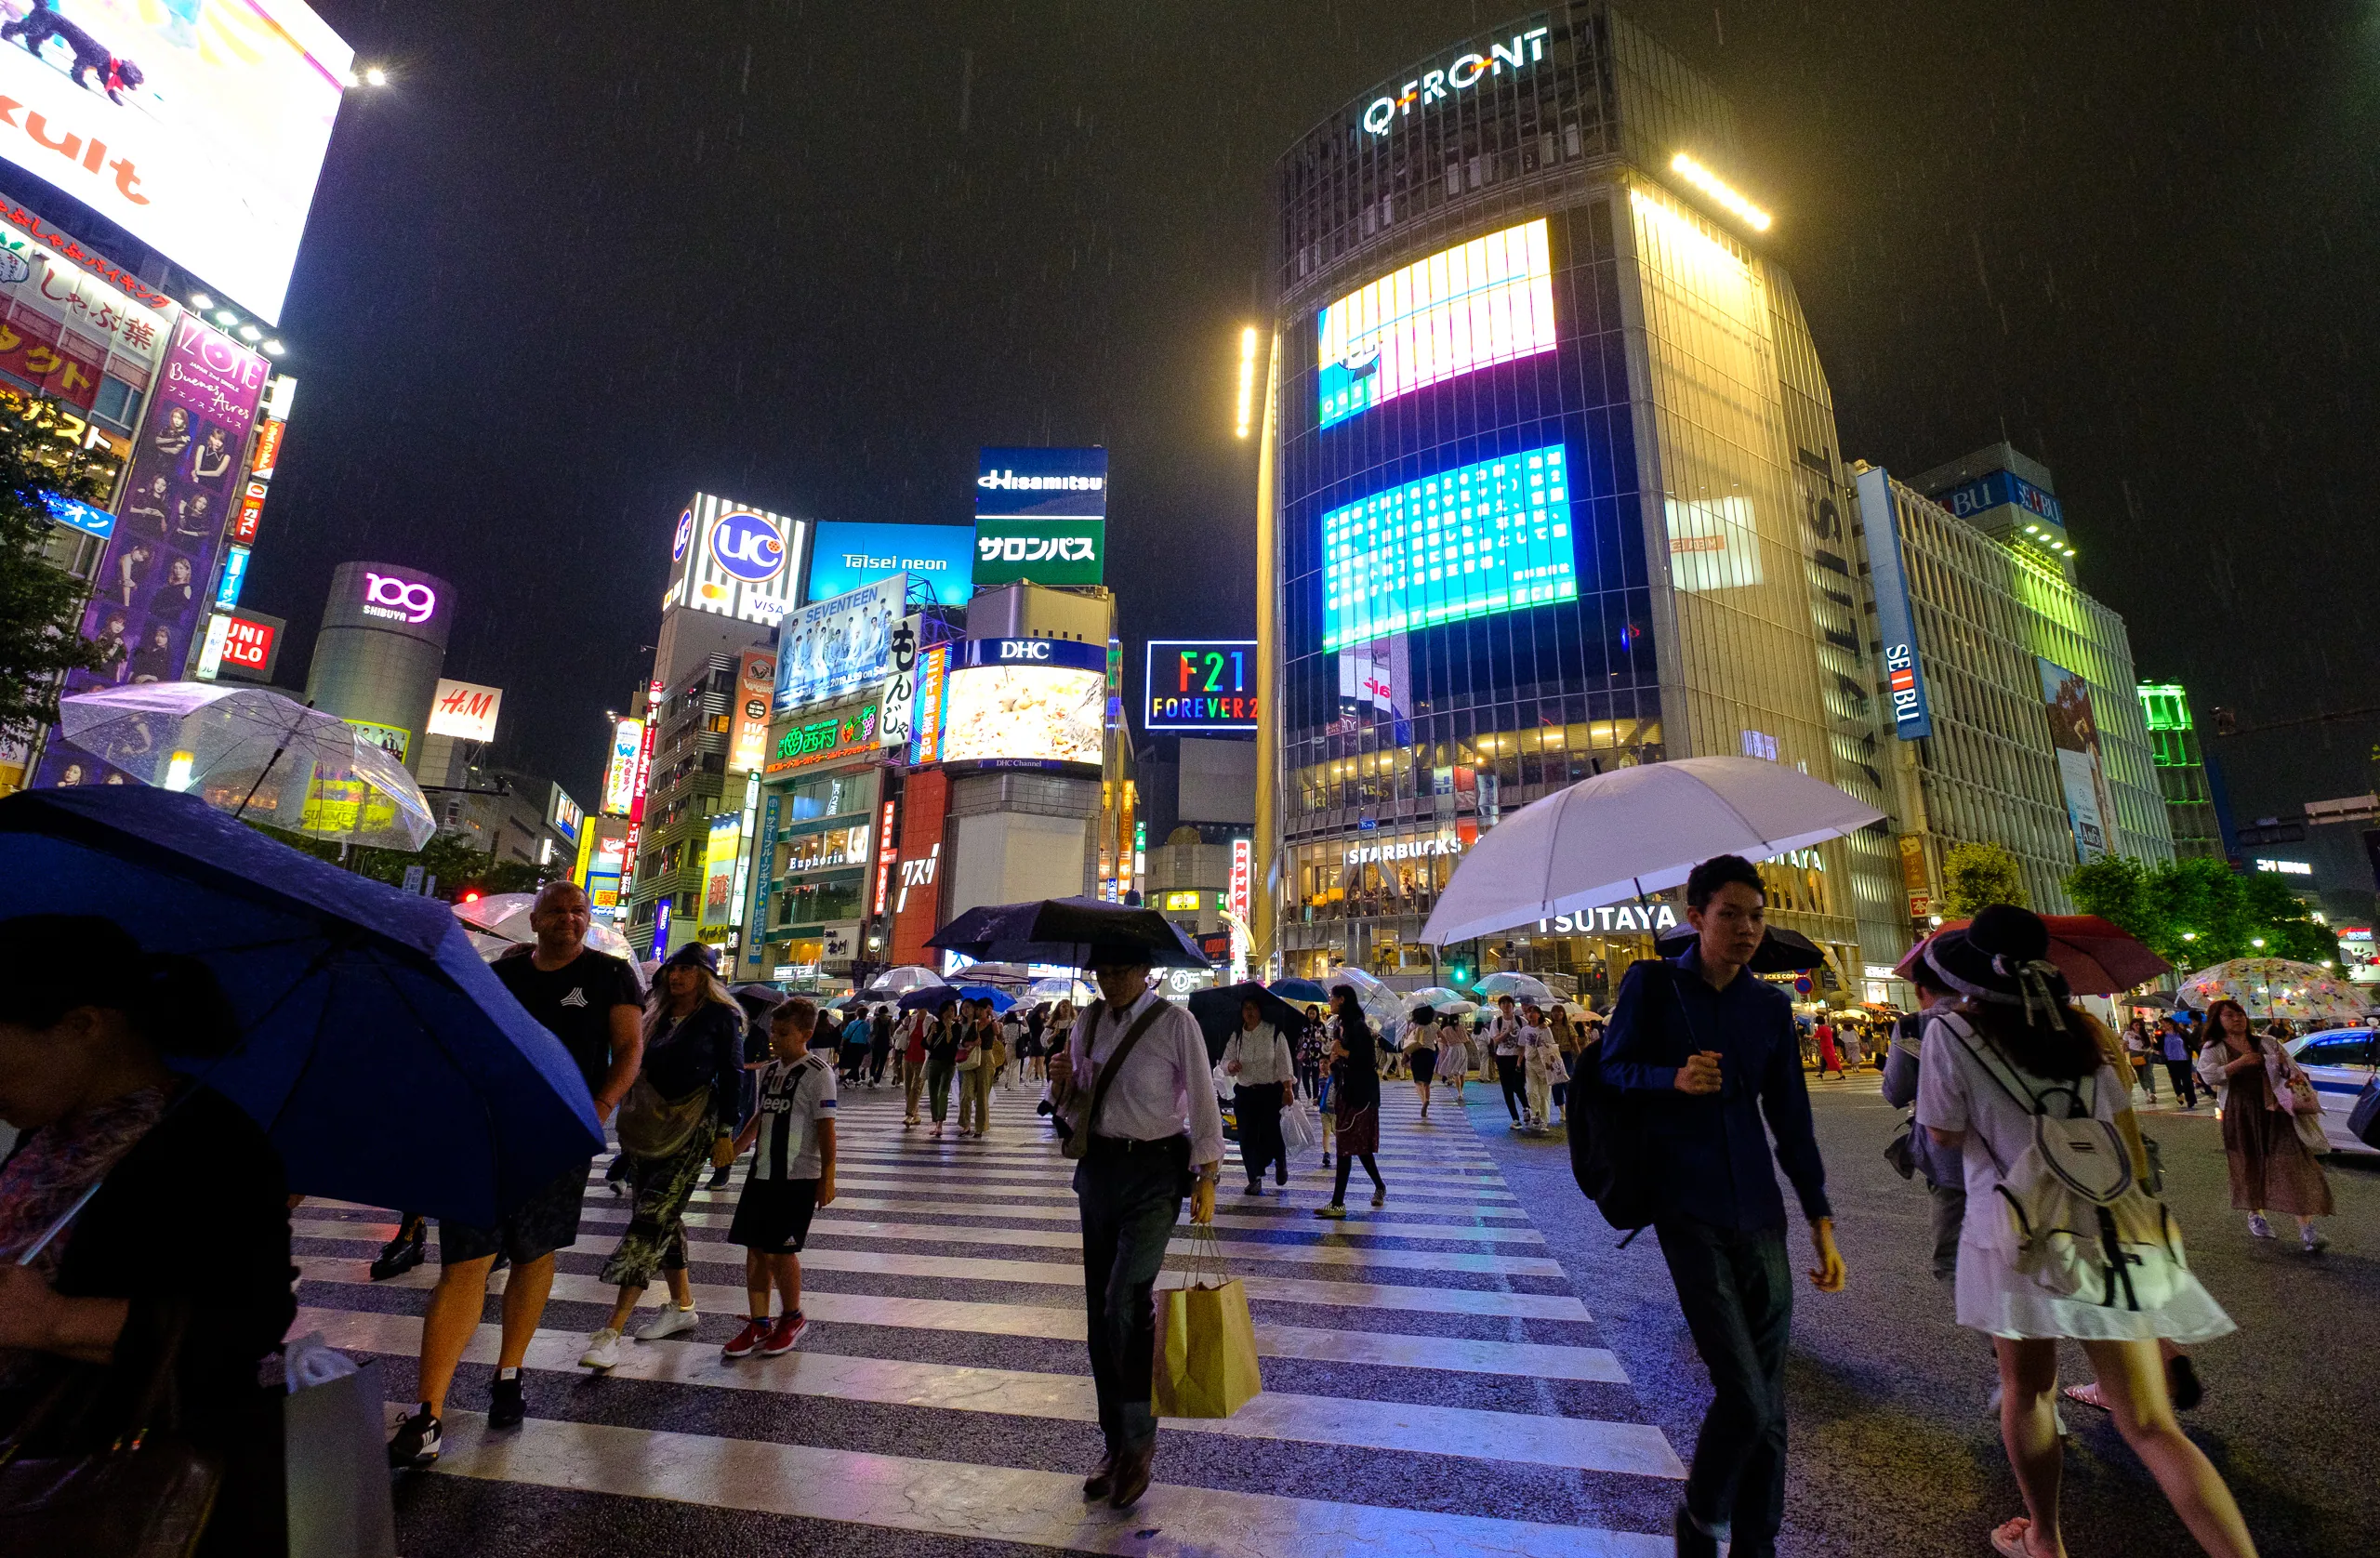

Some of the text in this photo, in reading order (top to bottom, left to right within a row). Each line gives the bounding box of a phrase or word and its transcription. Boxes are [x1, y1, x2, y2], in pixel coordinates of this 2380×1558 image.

[40, 267, 156, 351] しゃぶ葉
[977, 469, 1104, 492] Hisamitsu
[2017, 482, 2061, 523] SEIBU
[841, 553, 948, 572] Taisei neon
[977, 536, 1095, 562] サロンパス
[364, 572, 436, 624] 109
[754, 599, 784, 615] VISA
[805, 586, 879, 625] SEVENTEEN
[363, 604, 407, 622] SHIBUYA
[999, 640, 1051, 660] DHC
[883, 620, 919, 741] もんじゃ
[1178, 651, 1245, 693] F21
[1885, 643, 1920, 723] SEIBU
[439, 688, 495, 720] H&M
[1152, 697, 1247, 720] FOREVER
[759, 815, 777, 899] サマーフルーツギフト
[789, 854, 845, 872] Euphoria
[1348, 837, 1463, 865] STARBUCKS
[1912, 899, 1927, 914] 本
[760, 1093, 791, 1114] Jeep
